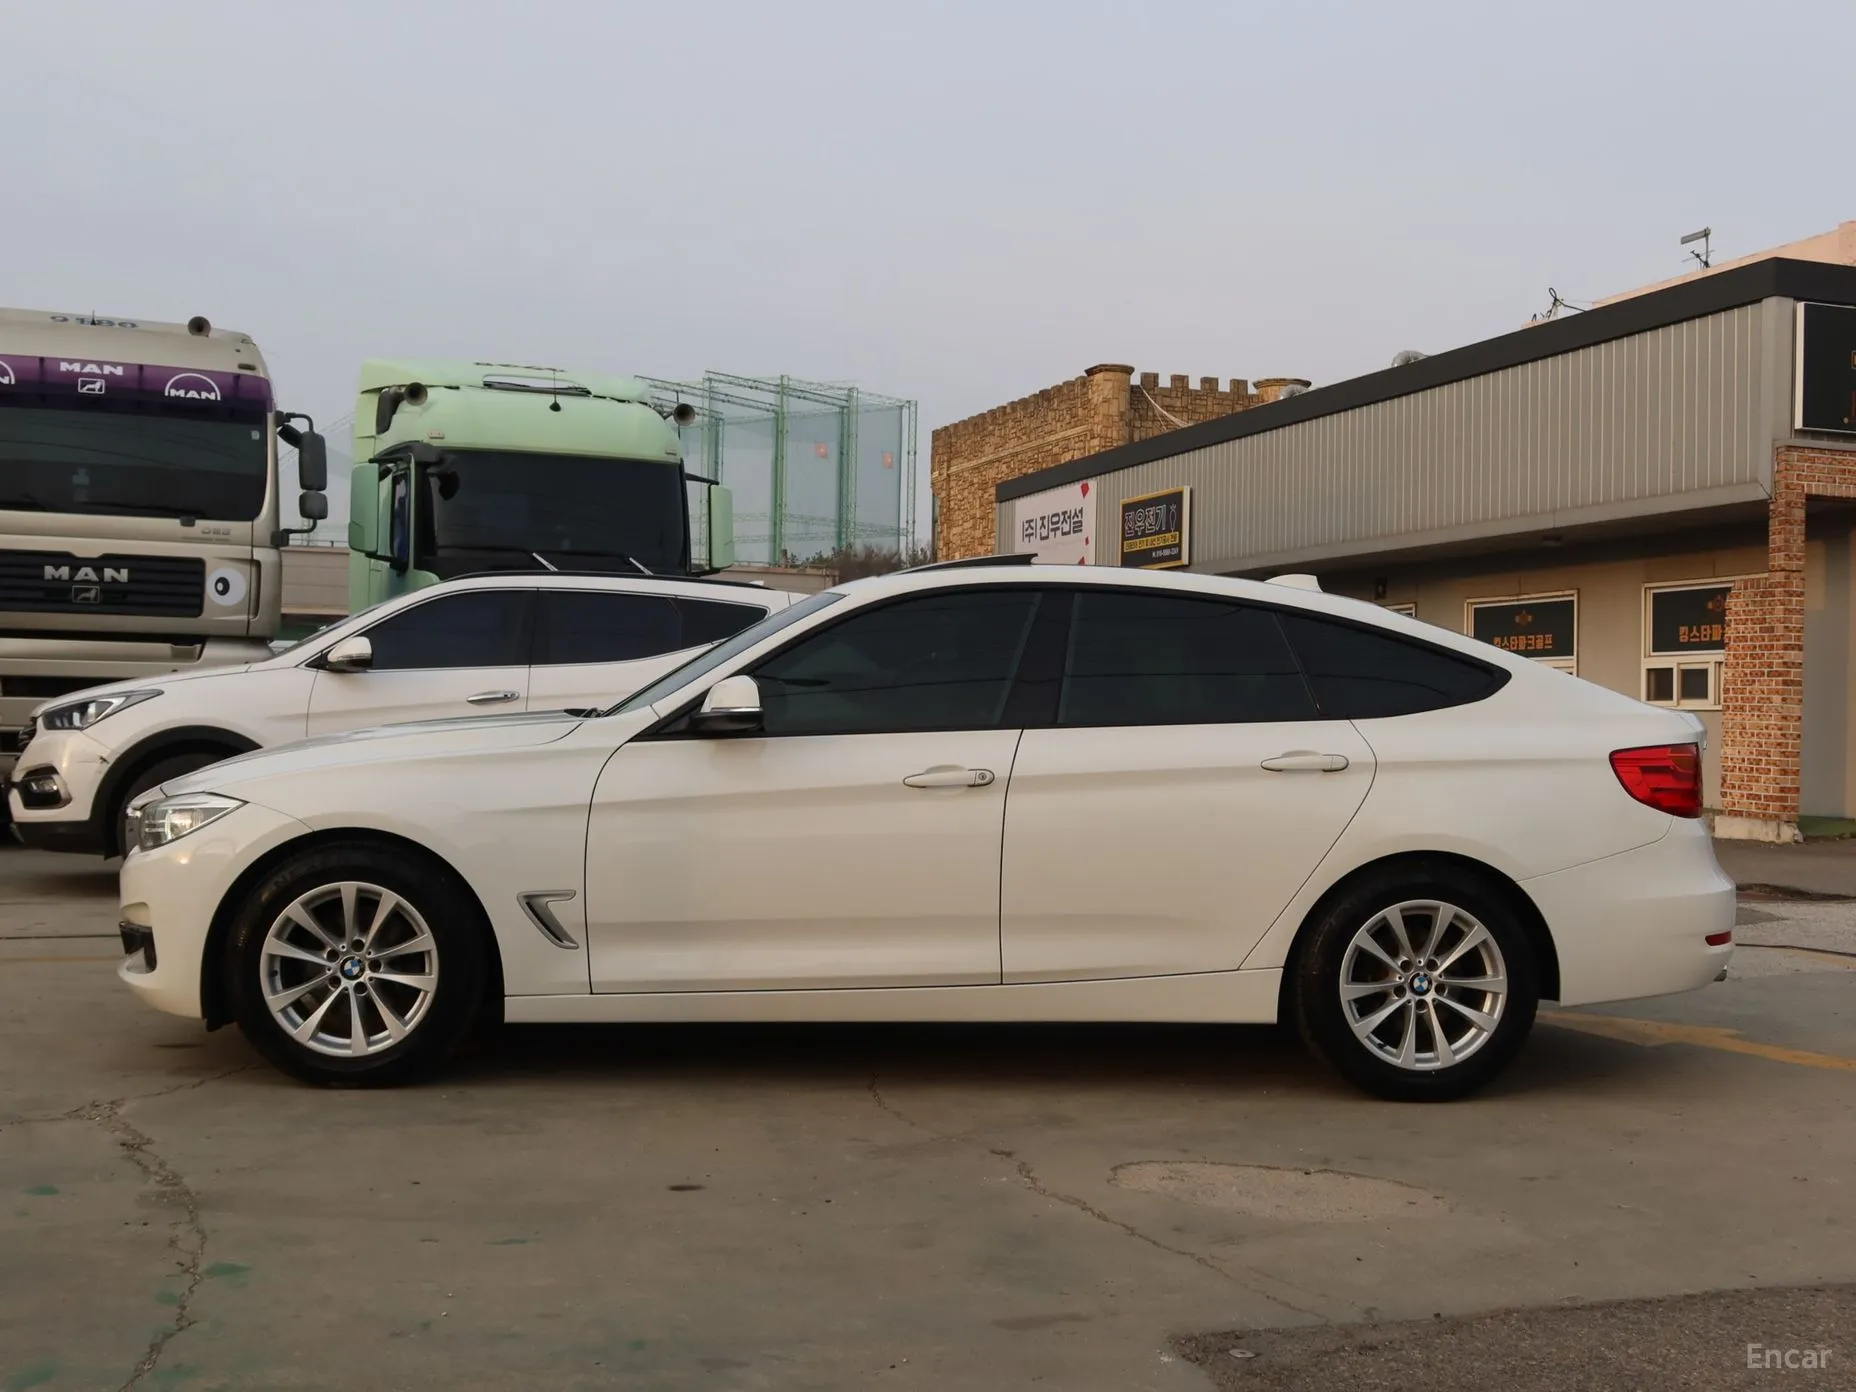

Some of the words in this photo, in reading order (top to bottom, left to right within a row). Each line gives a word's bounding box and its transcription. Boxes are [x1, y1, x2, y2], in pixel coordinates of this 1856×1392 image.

[60, 362, 123, 375] MAN
[170, 388, 216, 400] MAN
[44, 565, 128, 583] MAN
